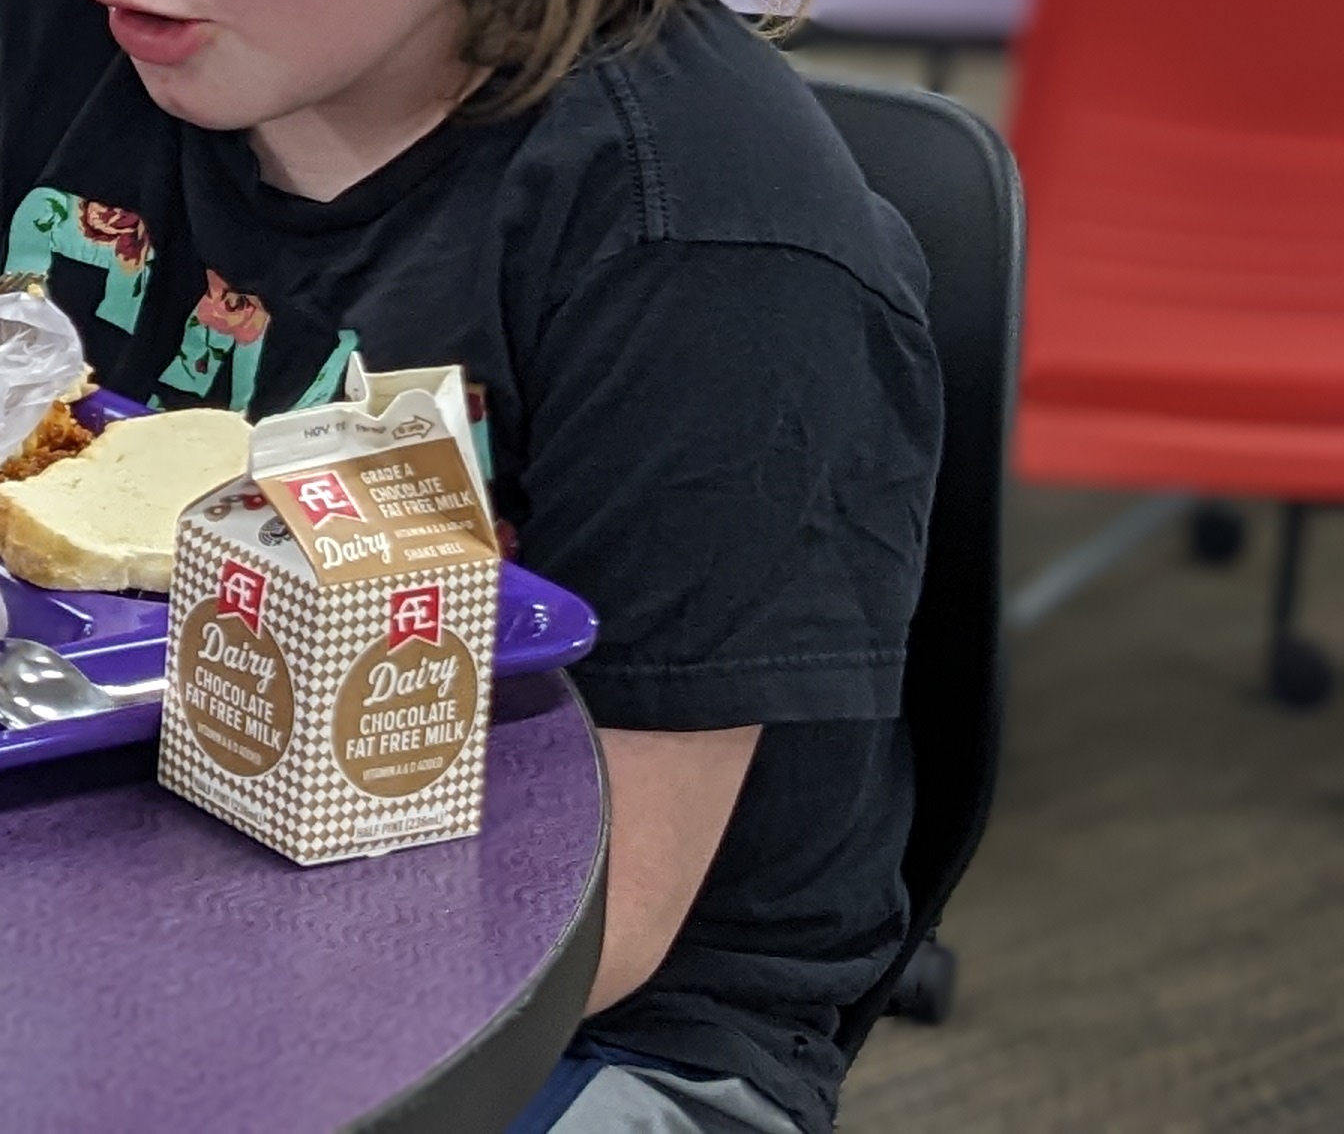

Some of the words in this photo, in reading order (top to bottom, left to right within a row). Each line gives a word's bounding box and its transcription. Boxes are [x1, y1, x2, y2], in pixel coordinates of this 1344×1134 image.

[360, 465, 403, 485] GRADE
[403, 462, 414, 477] A
[369, 476, 443, 503] CHOCOLATE
[378, 499, 404, 519] FAT
[404, 497, 436, 516] FREE
[435, 491, 475, 513] MILK
[315, 530, 392, 571] Dairy
[435, 542, 464, 556] WELL
[197, 622, 278, 694] Dairy
[194, 666, 274, 724] CHOCOLATE
[362, 653, 459, 708] Dairy
[185, 682, 207, 711] FAT
[209, 696, 243, 732] FREE
[245, 715, 283, 752] MILK
[359, 699, 458, 736] CHOCOLATE
[345, 736, 376, 760] FAT
[379, 729, 421, 755] FREE
[424, 719, 466, 747] MILK
